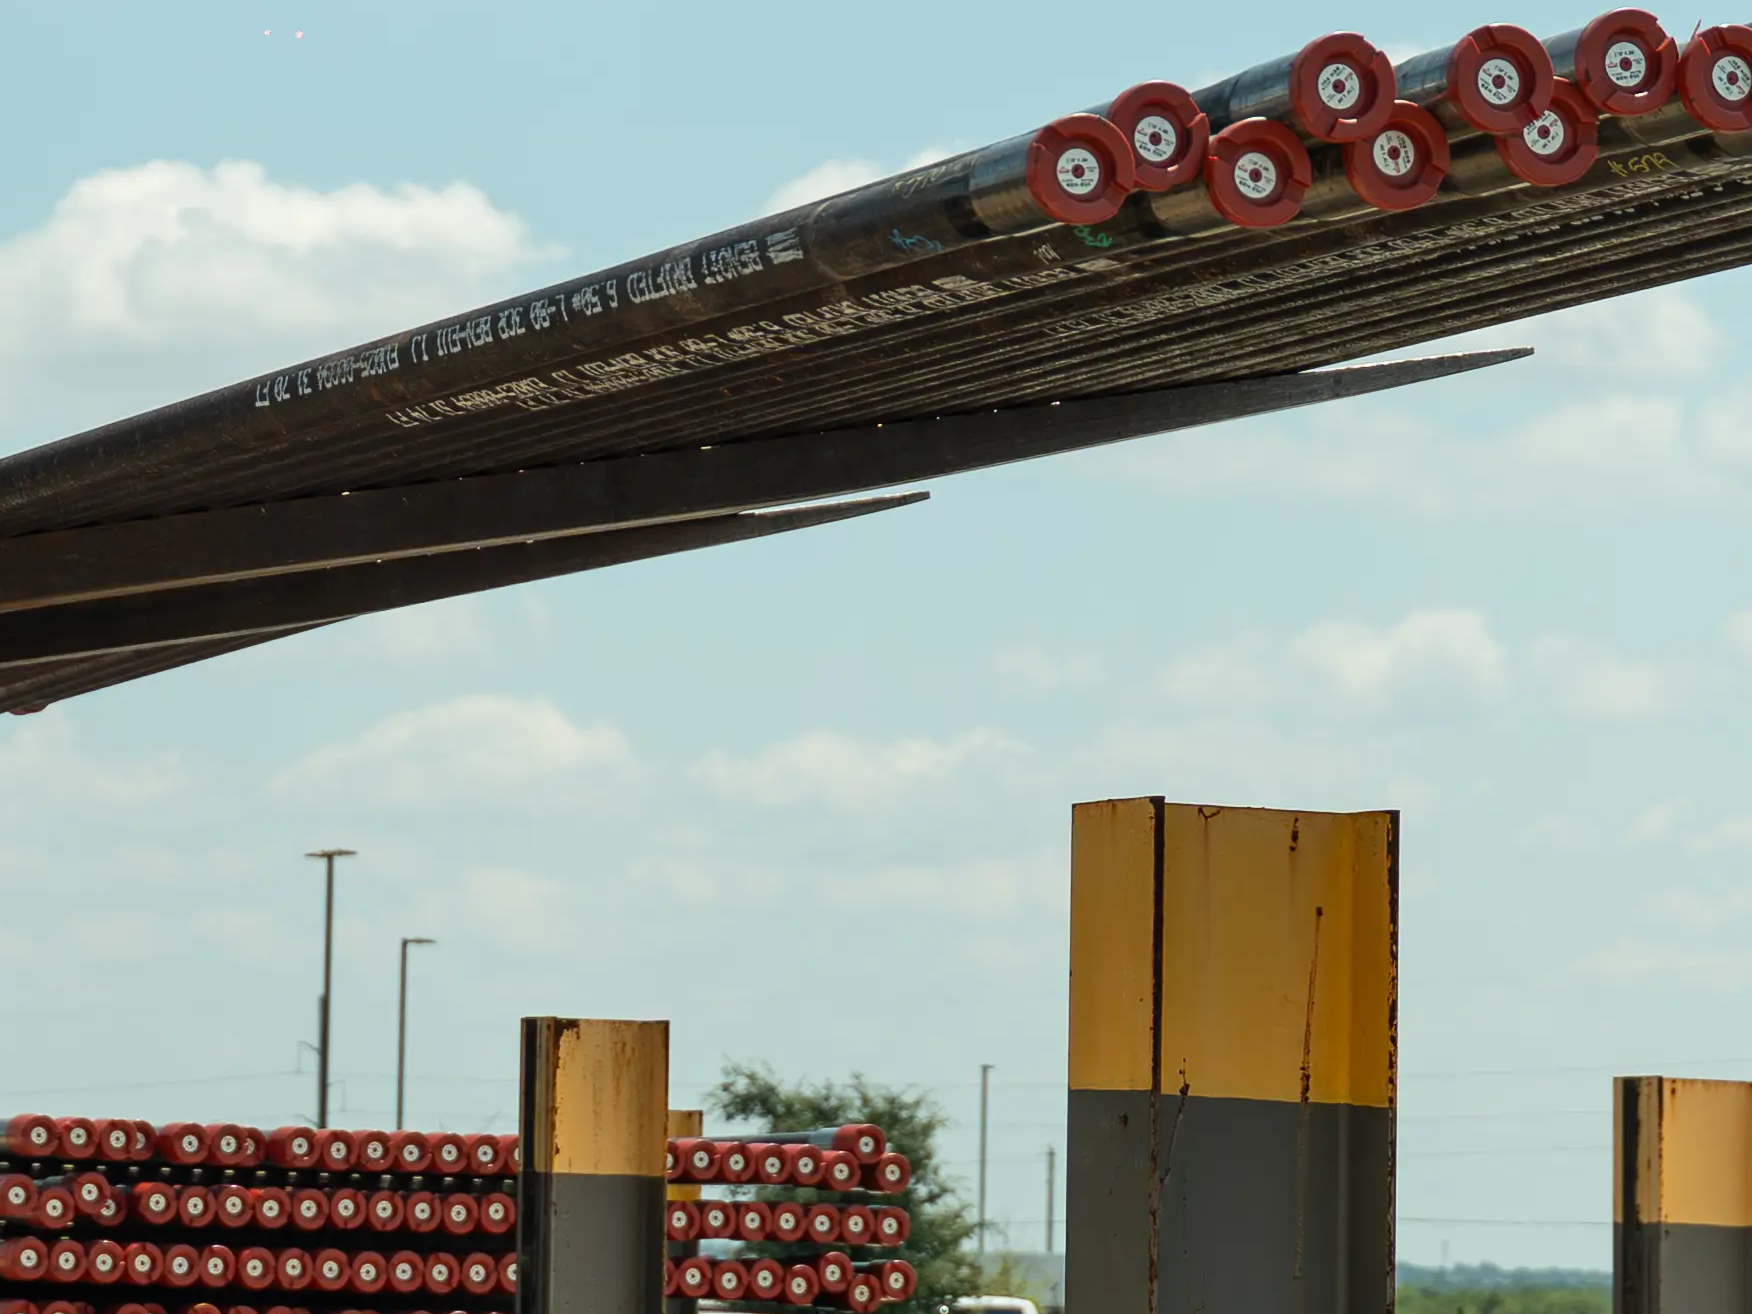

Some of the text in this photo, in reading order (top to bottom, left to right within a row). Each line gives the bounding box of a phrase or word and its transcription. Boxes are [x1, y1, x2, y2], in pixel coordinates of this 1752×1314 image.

[627, 257, 697, 305] DRIFTED
[700, 240, 763, 286] BENOIT
[530, 293, 568, 331] L-80
[572, 279, 617, 318] 6.50#
[497, 305, 525, 339] 3CR
[254, 379, 272, 409] FT
